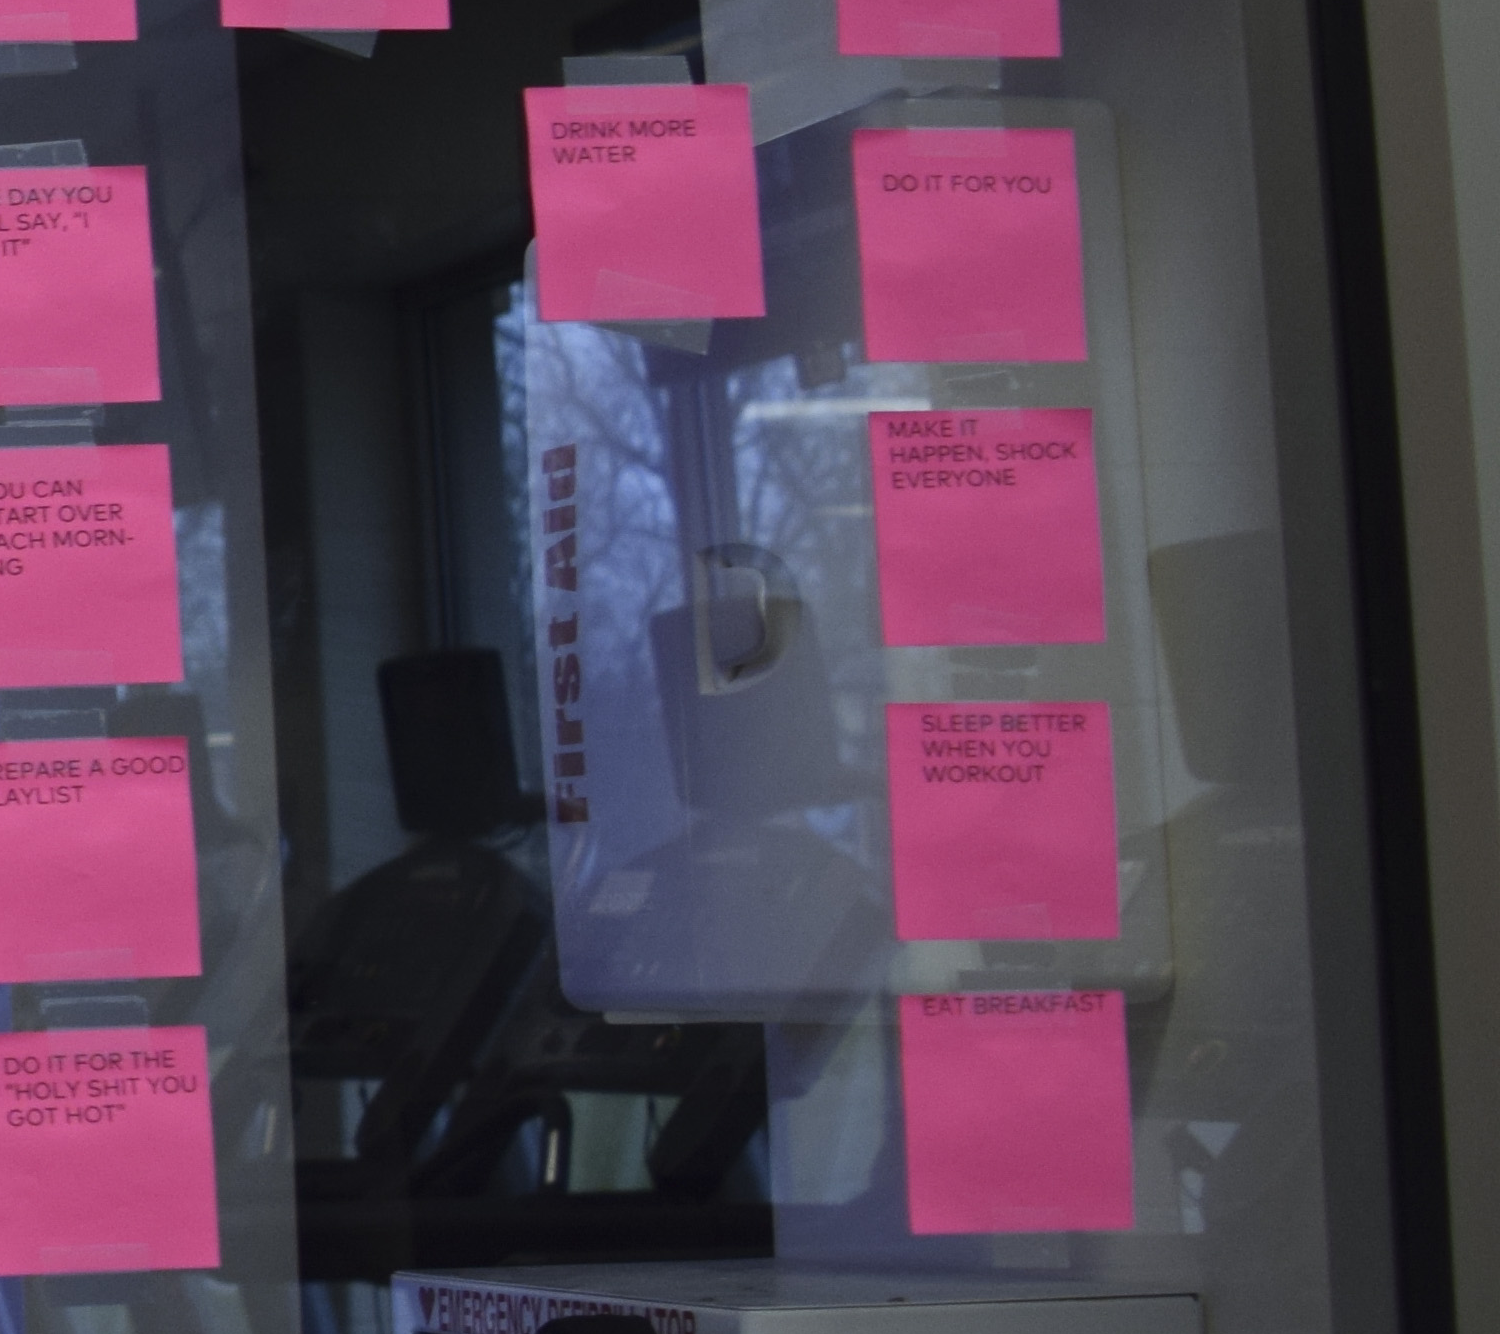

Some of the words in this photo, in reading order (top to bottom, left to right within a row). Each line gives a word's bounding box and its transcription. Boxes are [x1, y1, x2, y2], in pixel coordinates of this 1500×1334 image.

[551, 121, 622, 141] DRINK
[627, 118, 696, 139] MORE
[551, 144, 637, 165] WATER
[882, 173, 920, 193] DO
[924, 173, 944, 192] IT
[949, 173, 997, 194] FOR
[1001, 174, 1052, 195] YOU
[88, 758, 106, 777] A
[110, 754, 184, 777] GOOD
